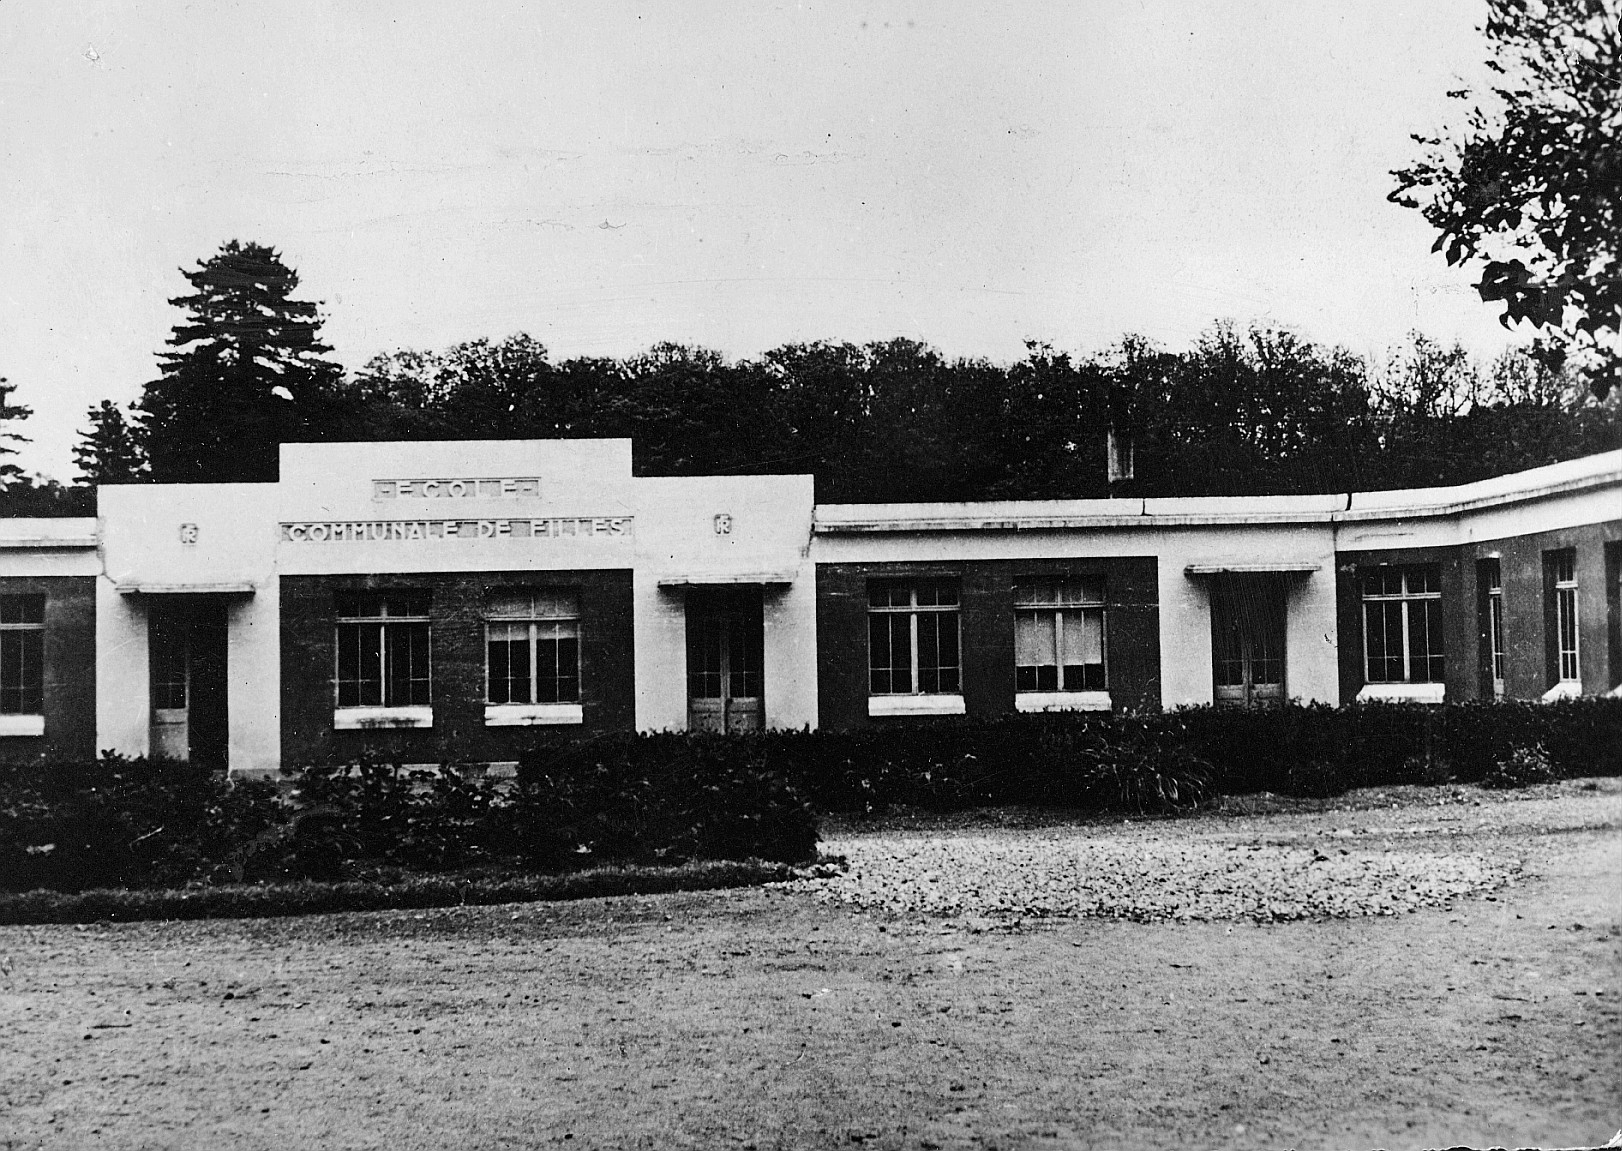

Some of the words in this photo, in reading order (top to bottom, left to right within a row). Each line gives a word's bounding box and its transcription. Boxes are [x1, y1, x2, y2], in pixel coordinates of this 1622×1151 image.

[288, 521, 459, 543] COMMUNALE
[477, 520, 513, 539] DE
[529, 517, 627, 538] FILLES
